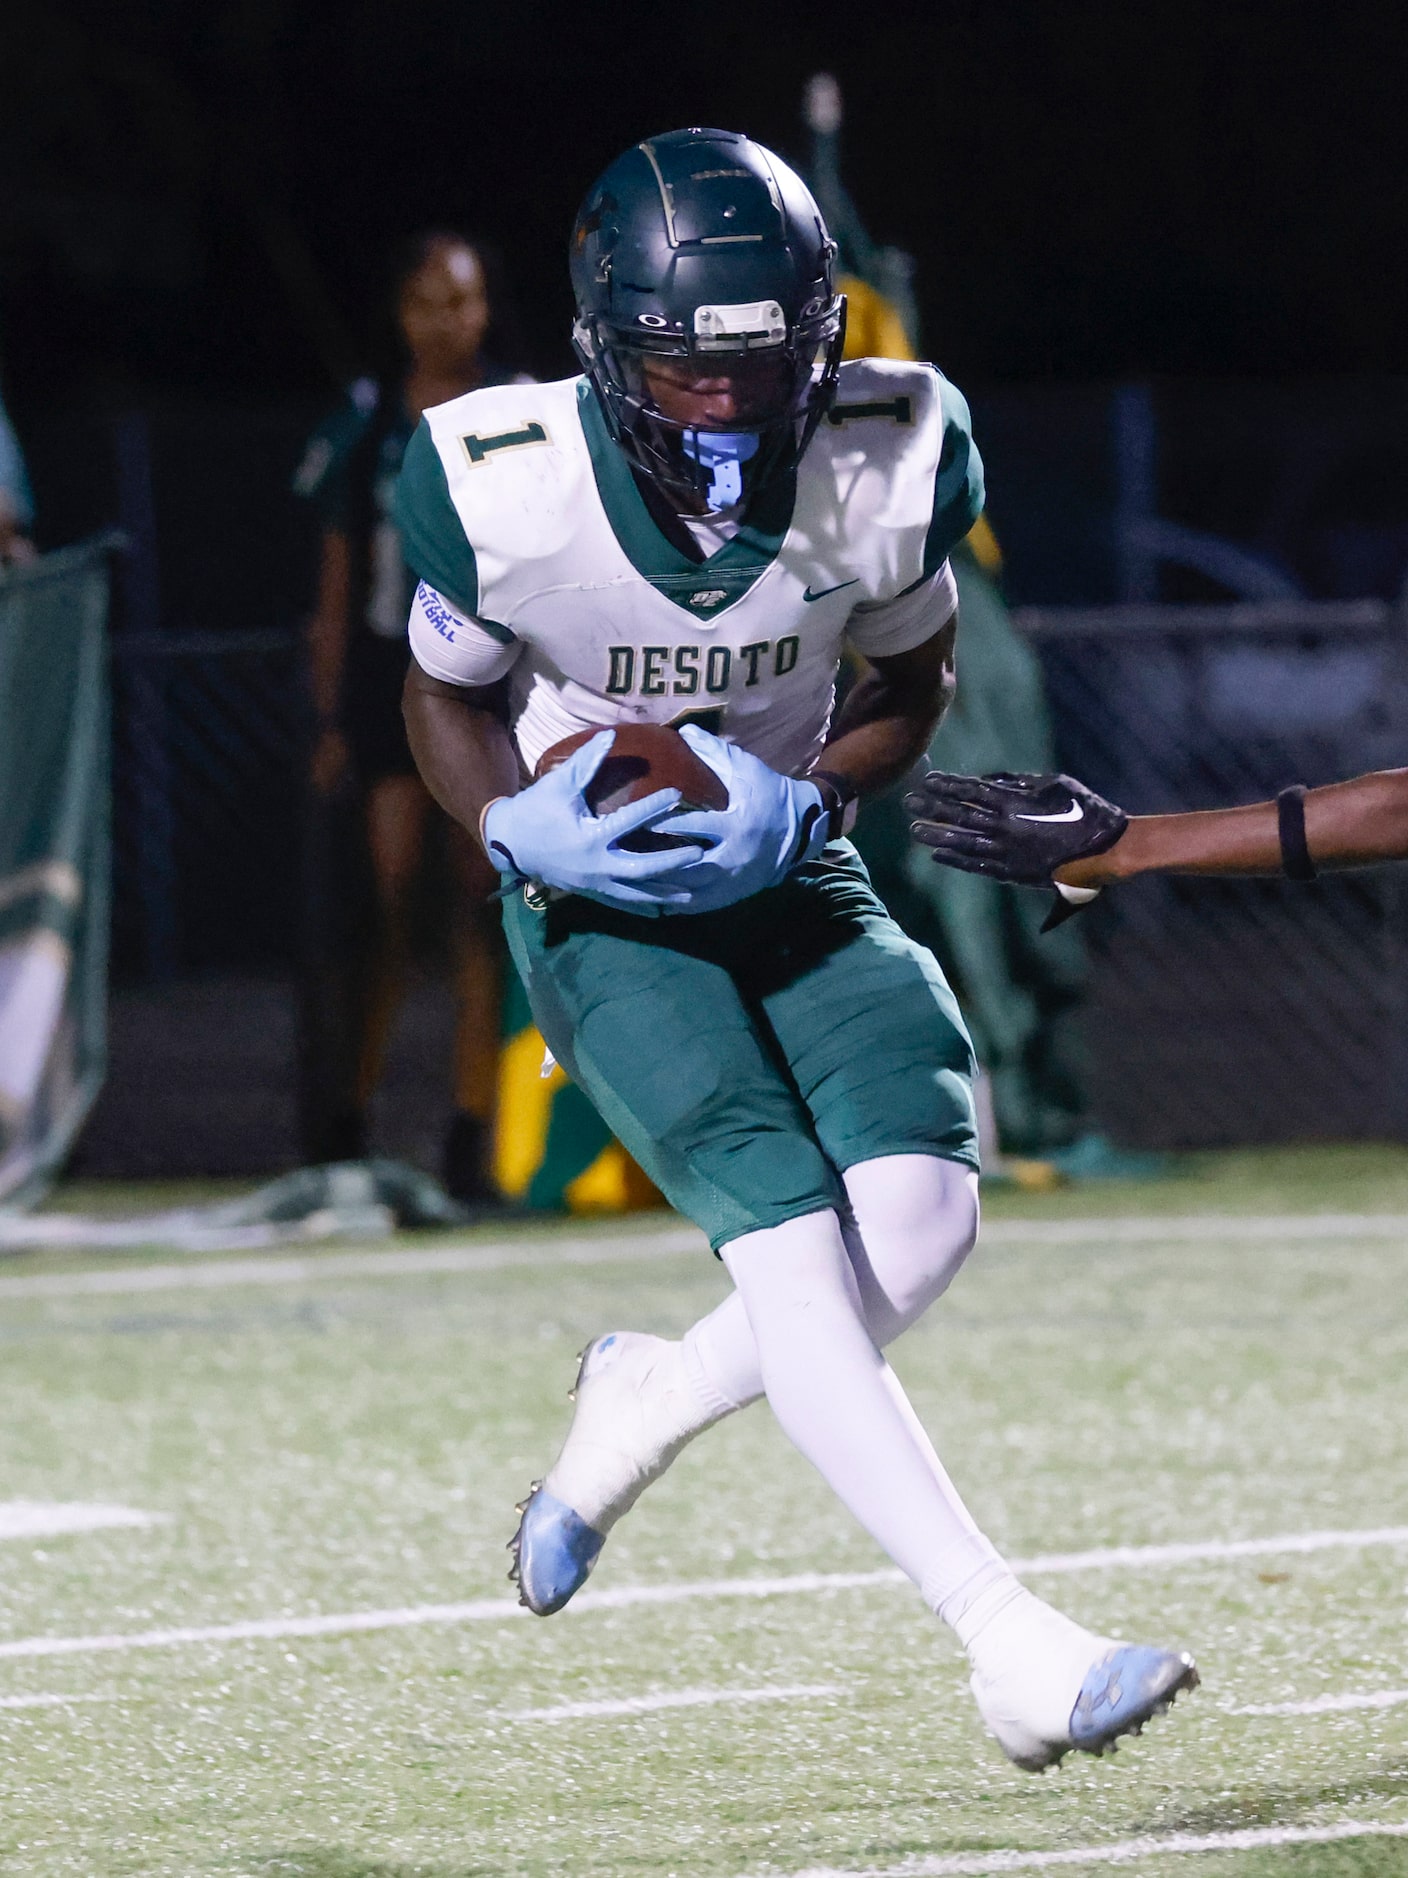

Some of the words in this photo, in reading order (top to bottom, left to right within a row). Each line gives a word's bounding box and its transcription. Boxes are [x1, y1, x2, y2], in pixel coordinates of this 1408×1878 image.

[824, 394, 917, 430] 1
[457, 419, 555, 470] 1
[604, 634, 800, 697] DESOTO
